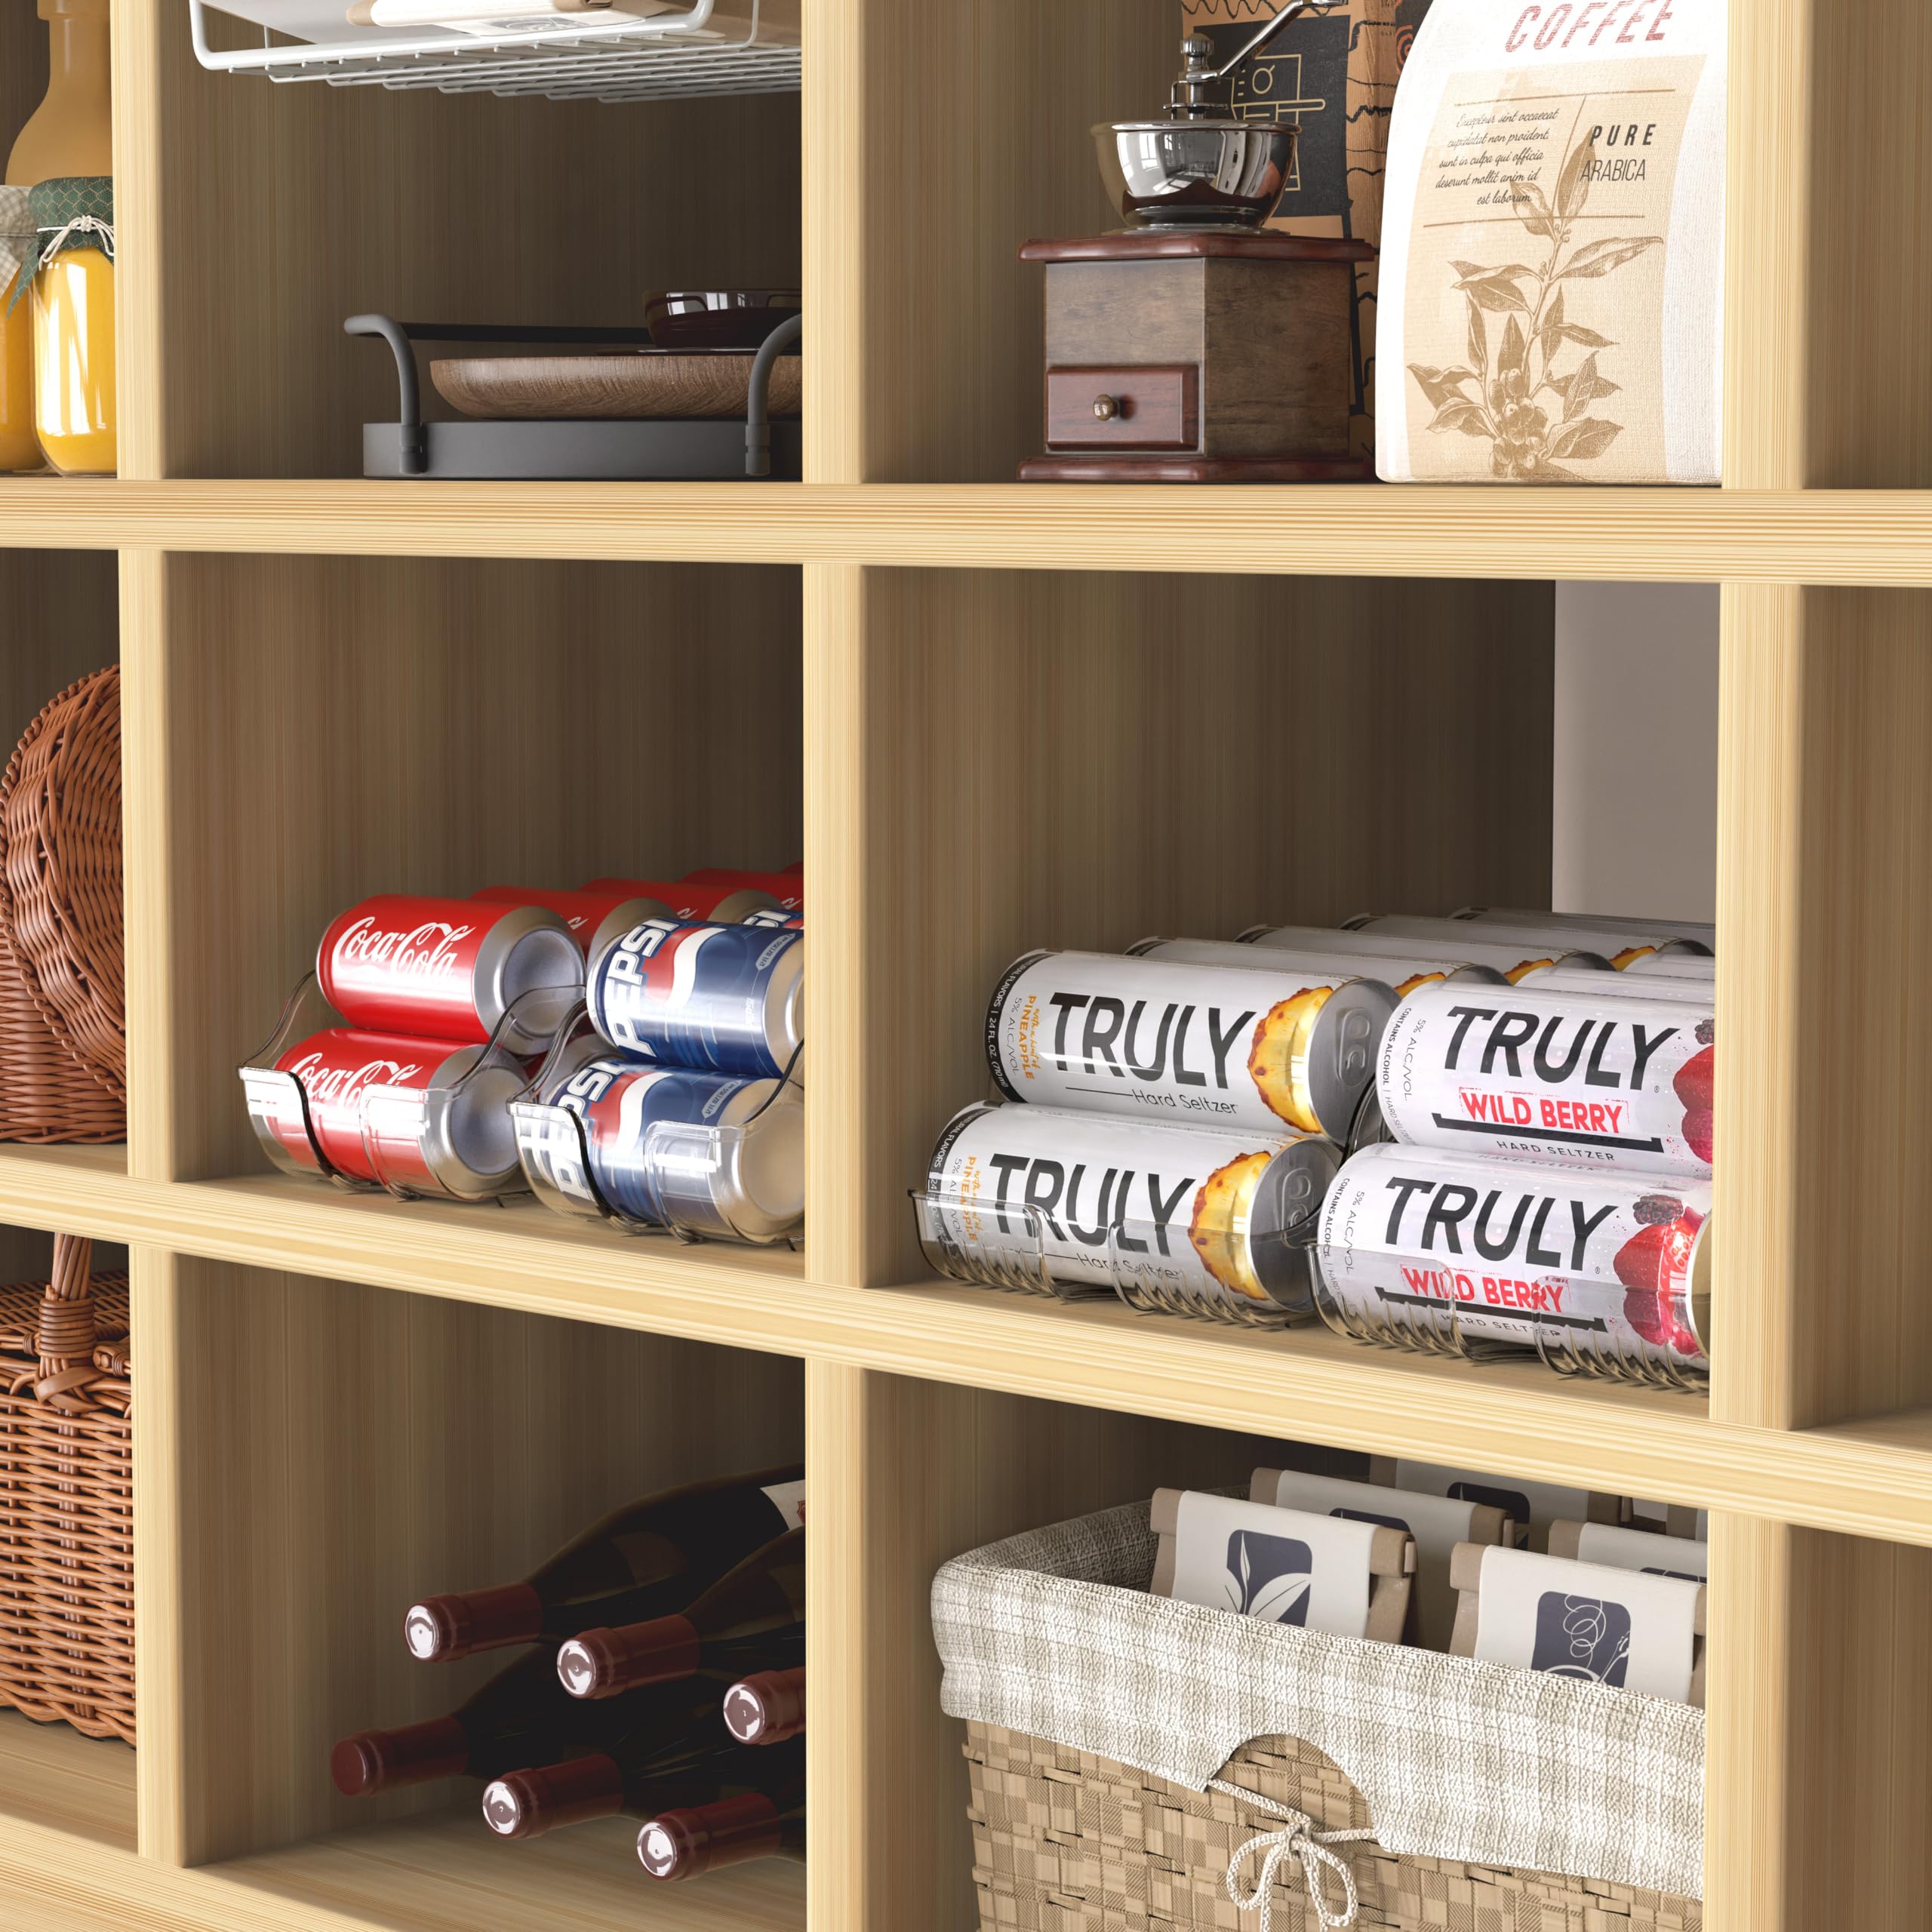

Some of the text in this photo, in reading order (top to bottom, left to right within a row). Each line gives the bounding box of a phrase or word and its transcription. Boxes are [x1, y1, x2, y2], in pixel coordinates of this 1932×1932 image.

[1505, 0, 1673, 52] COFFEE
[1497, 111, 1518, 123] sint
[1518, 108, 1560, 122] occaecat
[1488, 134, 1506, 143] non
[1589, 123, 1657, 147] PURE
[1438, 146, 1544, 168] sunt in culpa qui officia
[1435, 167, 1542, 189] deserunt mollit anim id
[1580, 158, 1645, 182] ARABICA
[1477, 189, 1532, 205] est laborum.
[331, 916, 475, 980] Coca-Cola
[605, 918, 680, 1057] PEPSI
[993, 975, 1016, 1008] FLAVORS
[1011, 997, 1023, 1013] 5%
[989, 1017, 997, 1029] 24
[1032, 1008, 1041, 1027] with
[1414, 1019, 1426, 1032] 5%
[988, 1030, 996, 1043] FL.
[1019, 995, 1038, 1081] PINEAPPLE
[1049, 992, 1257, 1089] TRULY
[1383, 1008, 1412, 1085] CONTAINS ALCOHOL
[988, 1044, 997, 1059] OZ.
[1444, 1005, 1680, 1091] TRULY
[991, 1060, 1003, 1077] (710
[1032, 1060, 1041, 1070] of
[290, 1052, 423, 1109] Coca-C
[1132, 1089, 1238, 1115] Hard Seltzer
[1384, 1096, 1398, 1118] HARD
[1460, 1092, 1623, 1134] WILD BERRY
[934, 1134, 955, 1168] FLAVORS
[1497, 1140, 1614, 1161] HARD SELTZER
[951, 1158, 962, 1174] 5%
[930, 1179, 938, 1190] 24
[1329, 1177, 1350, 1214] CONTAINS
[989, 1153, 1196, 1257] TRULY
[1352, 1191, 1365, 1206] 5%
[1384, 1177, 1618, 1272] TRULY
[1327, 1269, 1340, 1291] HARD
[1481, 1276, 1563, 1312] BERRY
